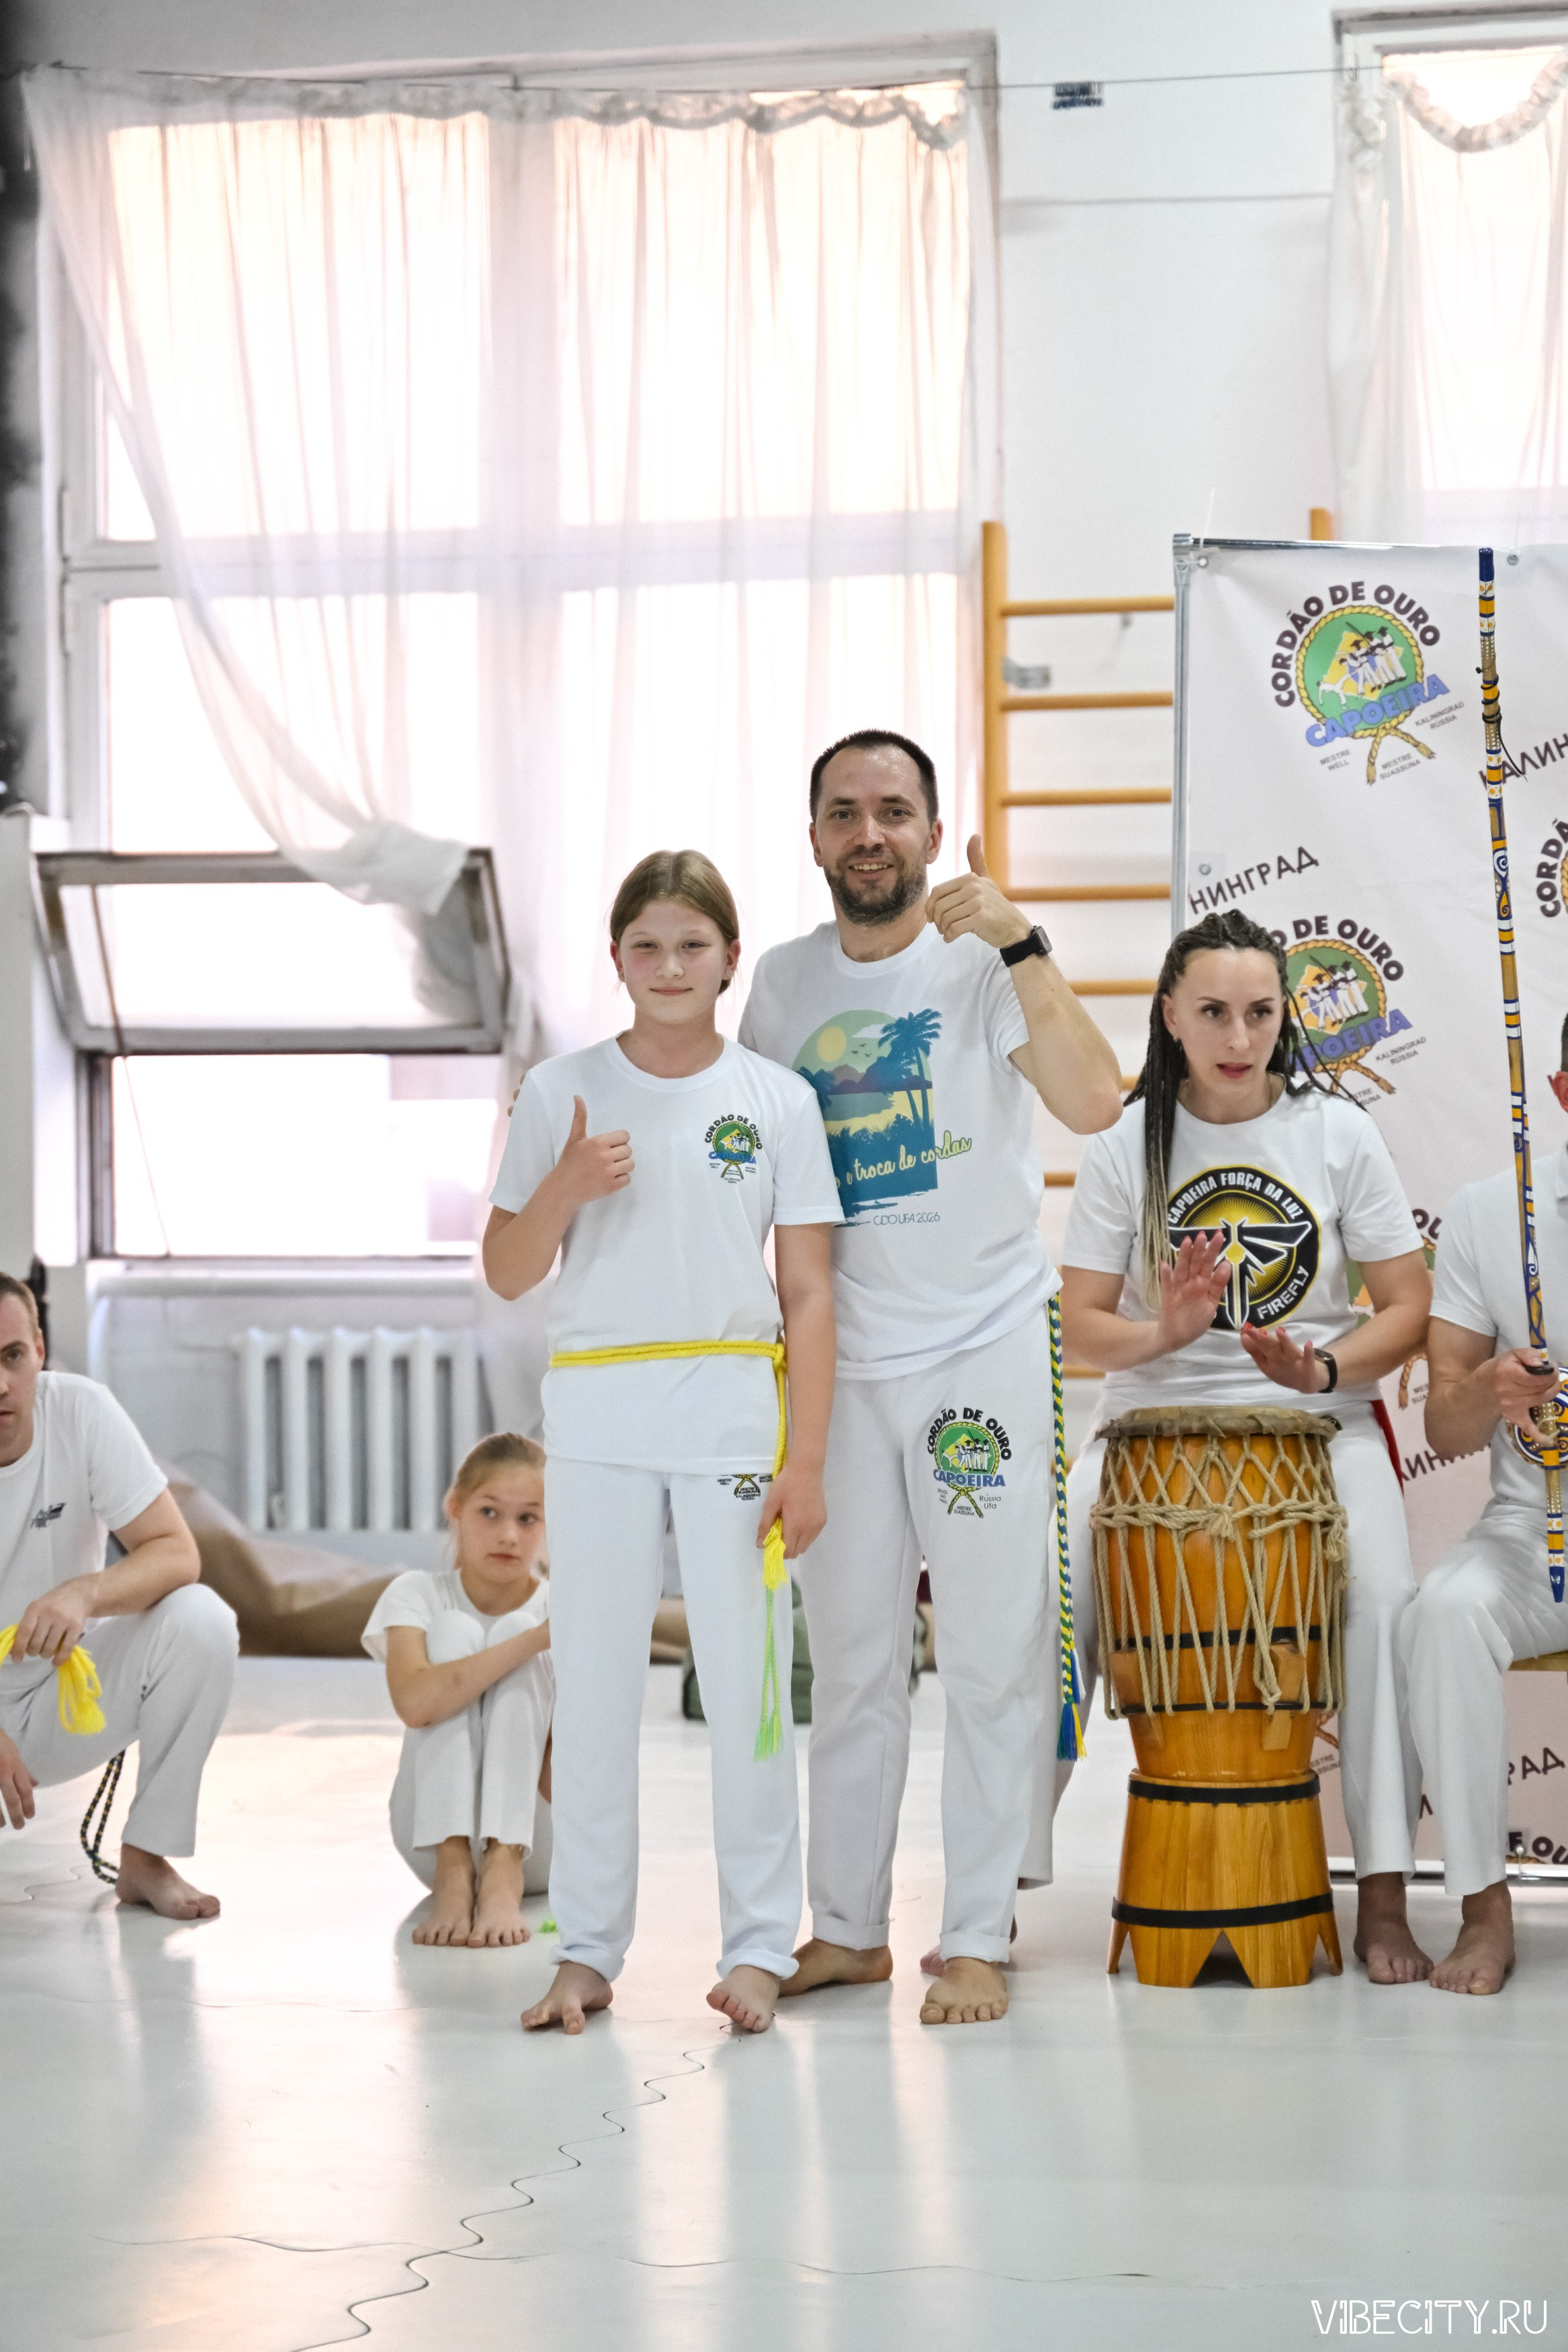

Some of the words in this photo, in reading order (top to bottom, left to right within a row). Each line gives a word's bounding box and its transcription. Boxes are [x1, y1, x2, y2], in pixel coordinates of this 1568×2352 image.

[1271, 596, 1324, 707] CORDÃO
[1329, 581, 1365, 605] DE
[1374, 584, 1440, 646] OURO
[1305, 673, 1450, 747] CAPOEIRA
[1415, 702, 1465, 727] KALININGRAD
[1430, 714, 1458, 730] RUSSIA
[1319, 749, 1352, 765] MESTRE
[1327, 759, 1350, 771] WELL
[1379, 759, 1422, 780] SUASSUNA
[1381, 753, 1413, 770] MESTRE
[1190, 846, 1319, 915] НИНГРАД
[1293, 915, 1329, 939] DE
[1338, 919, 1404, 981] OURO
[1375, 1036, 1427, 1062] KALININGRAD
[1390, 1050, 1419, 1065] RUSSIA
[704, 1114, 735, 1143] CORDÃO
[737, 1115, 749, 1125] DE
[853, 1158, 896, 1181] troca
[899, 1144, 916, 1171] de
[920, 1130, 972, 1160] cordas
[1168, 1176, 1218, 1224] CAPOEIRA
[1220, 1171, 1262, 1191] FORÇA
[1264, 1183, 1284, 1202] DA
[1281, 1197, 1305, 1220] LUZ
[916, 1211, 941, 1223] 2026
[1256, 1265, 1309, 1320] FIREFLY
[927, 1408, 957, 1455] CORDÃO
[963, 1407, 984, 1423] DE
[986, 1418, 1012, 1461] OURO
[932, 1468, 1006, 1488] CAPOEIRA
[953, 1509, 975, 1517] SUASSUNA
